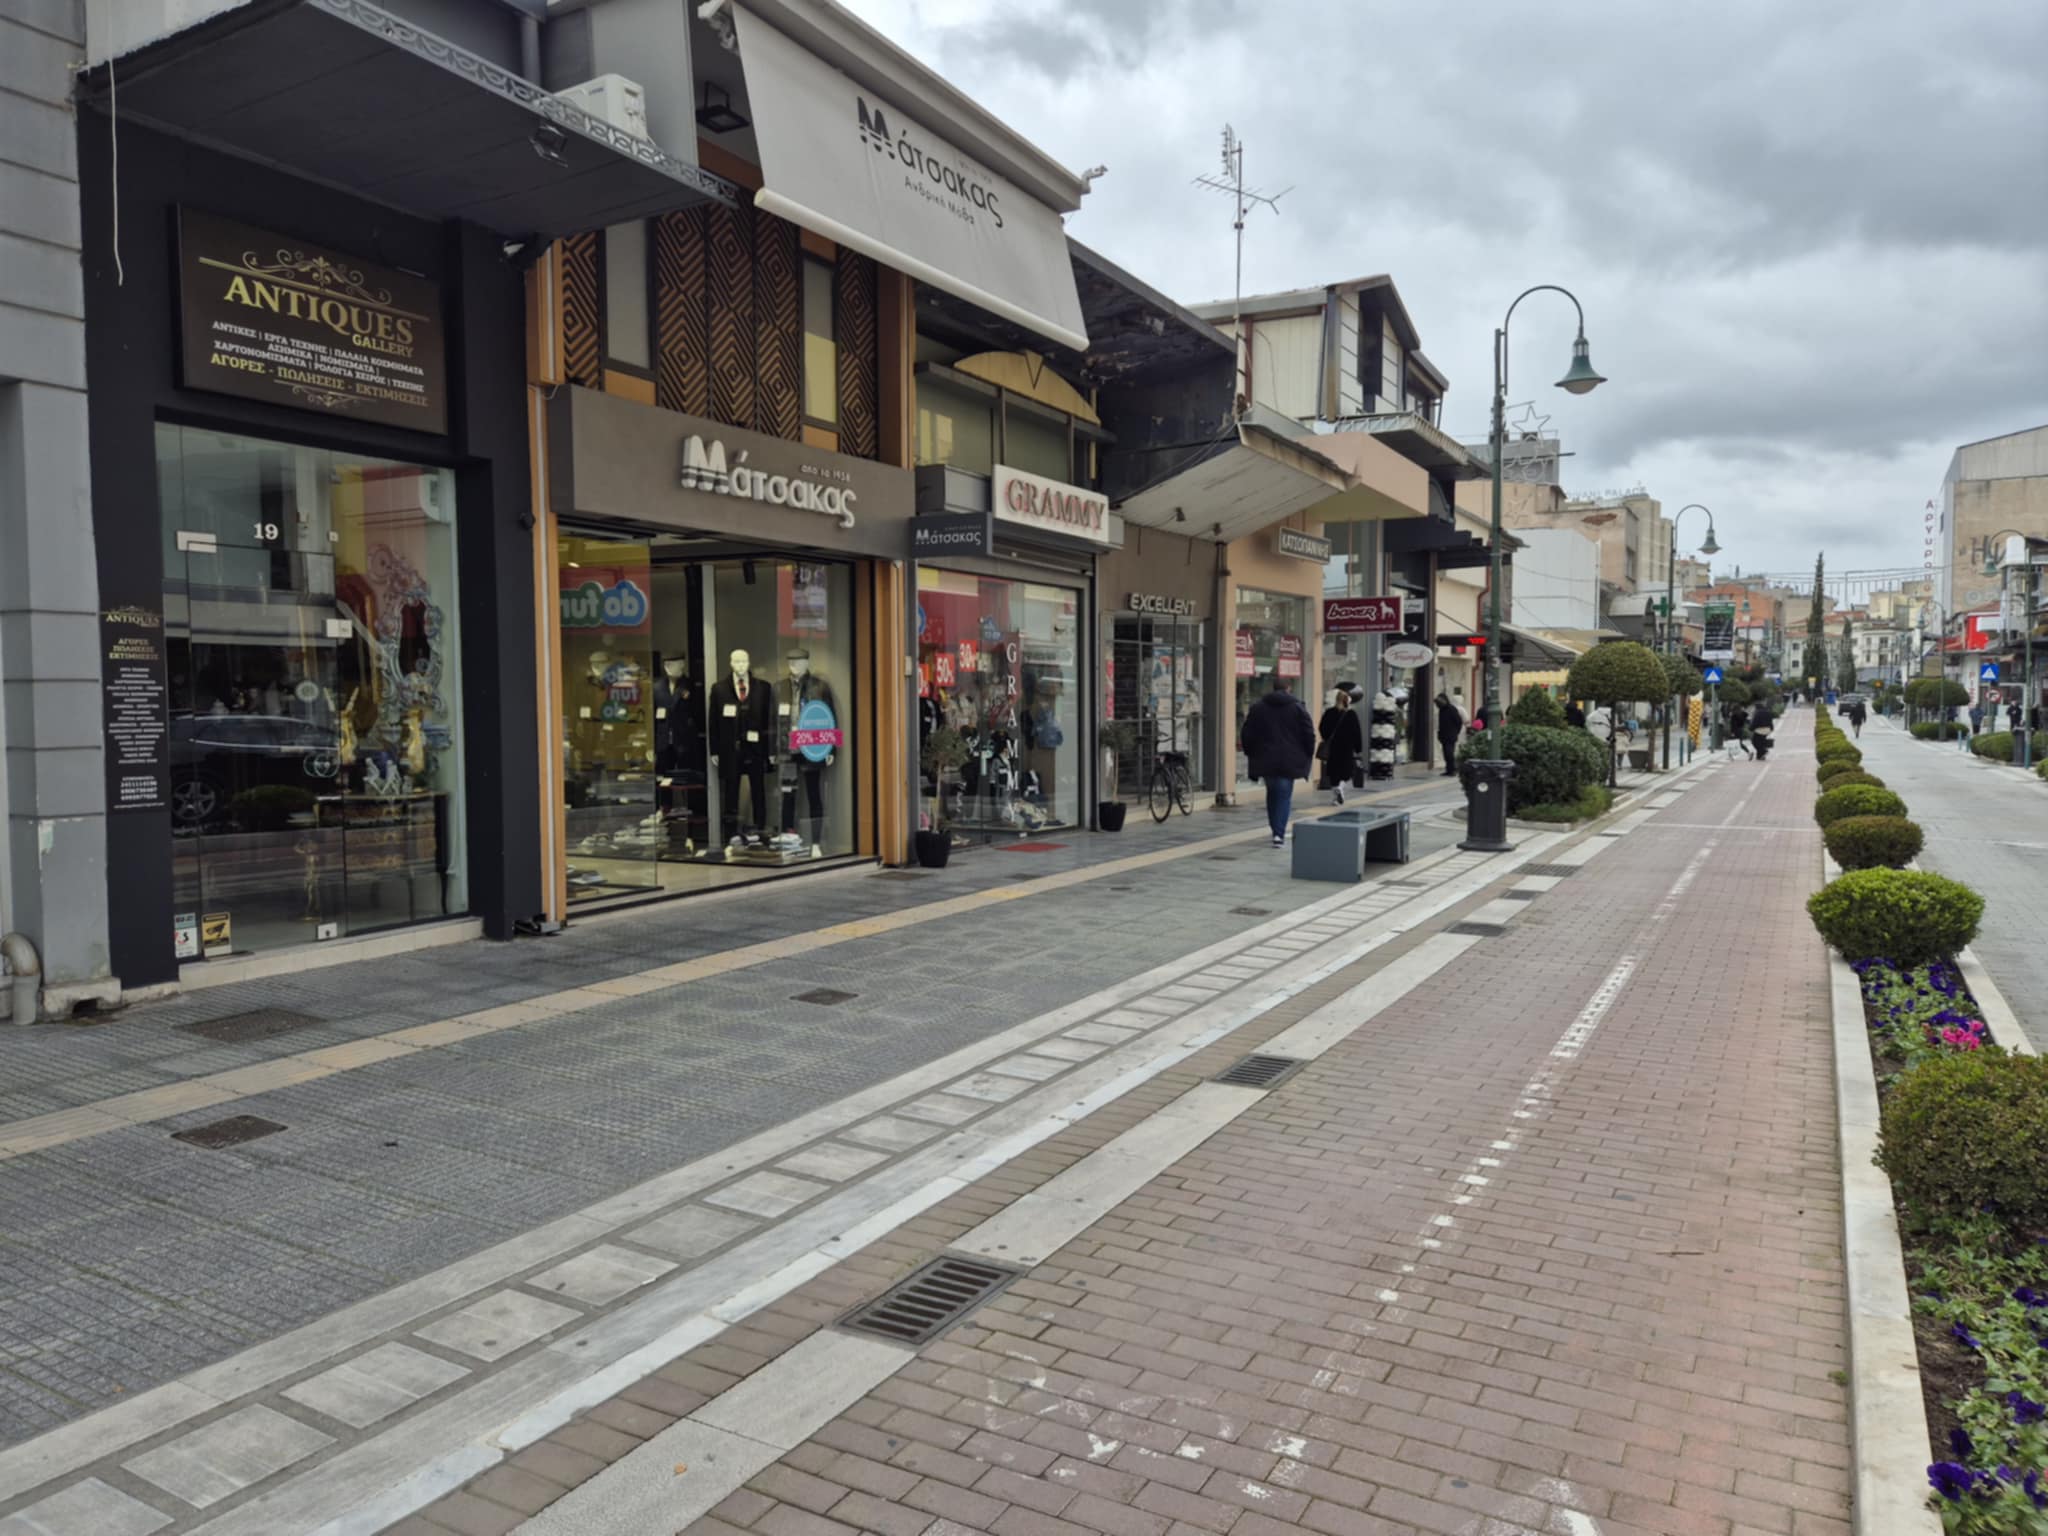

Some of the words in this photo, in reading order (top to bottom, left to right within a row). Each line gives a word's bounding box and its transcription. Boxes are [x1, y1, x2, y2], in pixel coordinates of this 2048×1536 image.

[857, 96, 1003, 228] Μάτσακας
[224, 275, 414, 345] ANTIQUES
[212, 321, 257, 338] ΑΝΤΙΚΕΣ
[264, 332, 288, 345] ΕΡΓΑ
[290, 338, 328, 354] ΤΕΧΝΗΣ
[334, 349, 369, 363] ΠΑΛΑΙΑ
[213, 340, 307, 368] ΧΑΡΤΟΝΟΜΙΣΜΑΤΑ
[314, 362, 353, 378] ΡΟΛΟΓΙΑ
[355, 371, 386, 384] ΧΕΙΡΟΣ
[268, 343, 313, 360] ΑΣΗΜΙΚΑ
[320, 354, 375, 373] ΝΟΜΙΣΜΑΤΑ
[352, 333, 415, 358] GALLERY
[211, 353, 265, 374] ΑΓΟΡΕΣ
[277, 366, 345, 390] ΠΩΛΗΣΕΙΣ
[356, 384, 428, 407] ΕΚΤΙΜΗΣΕΙΣ
[681, 435, 857, 529] Μάτσακας
[1005, 478, 1106, 530] GRAMMY
[253, 523, 279, 540] 19
[915, 528, 982, 546] Μάτσακας
[1131, 592, 1197, 616] EXCELLENT
[1006, 642, 1018, 823] GRAMMY
